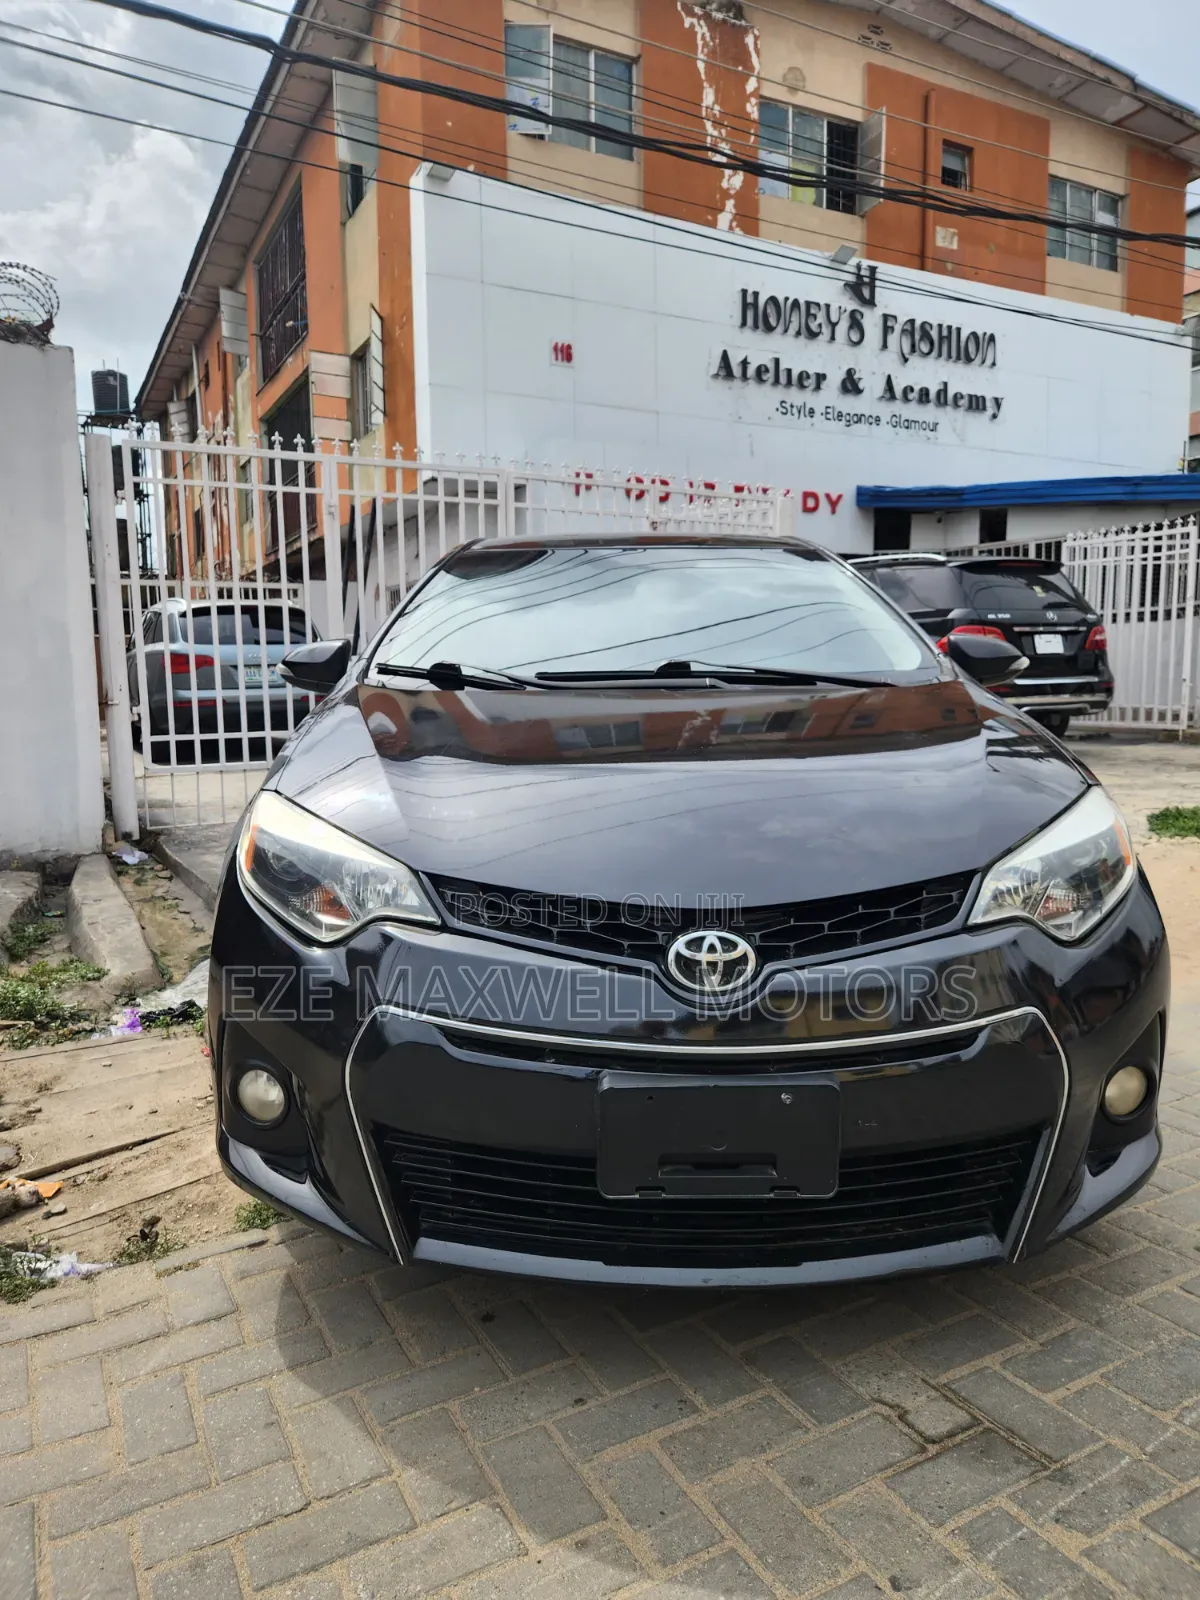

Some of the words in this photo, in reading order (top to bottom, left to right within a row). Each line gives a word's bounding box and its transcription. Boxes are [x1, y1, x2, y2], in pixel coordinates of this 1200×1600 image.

[739, 288, 865, 347] HONEY'S
[879, 312, 997, 369] FASHION
[711, 349, 828, 392] Atelier
[840, 366, 865, 396] &
[878, 373, 1005, 421] Academy
